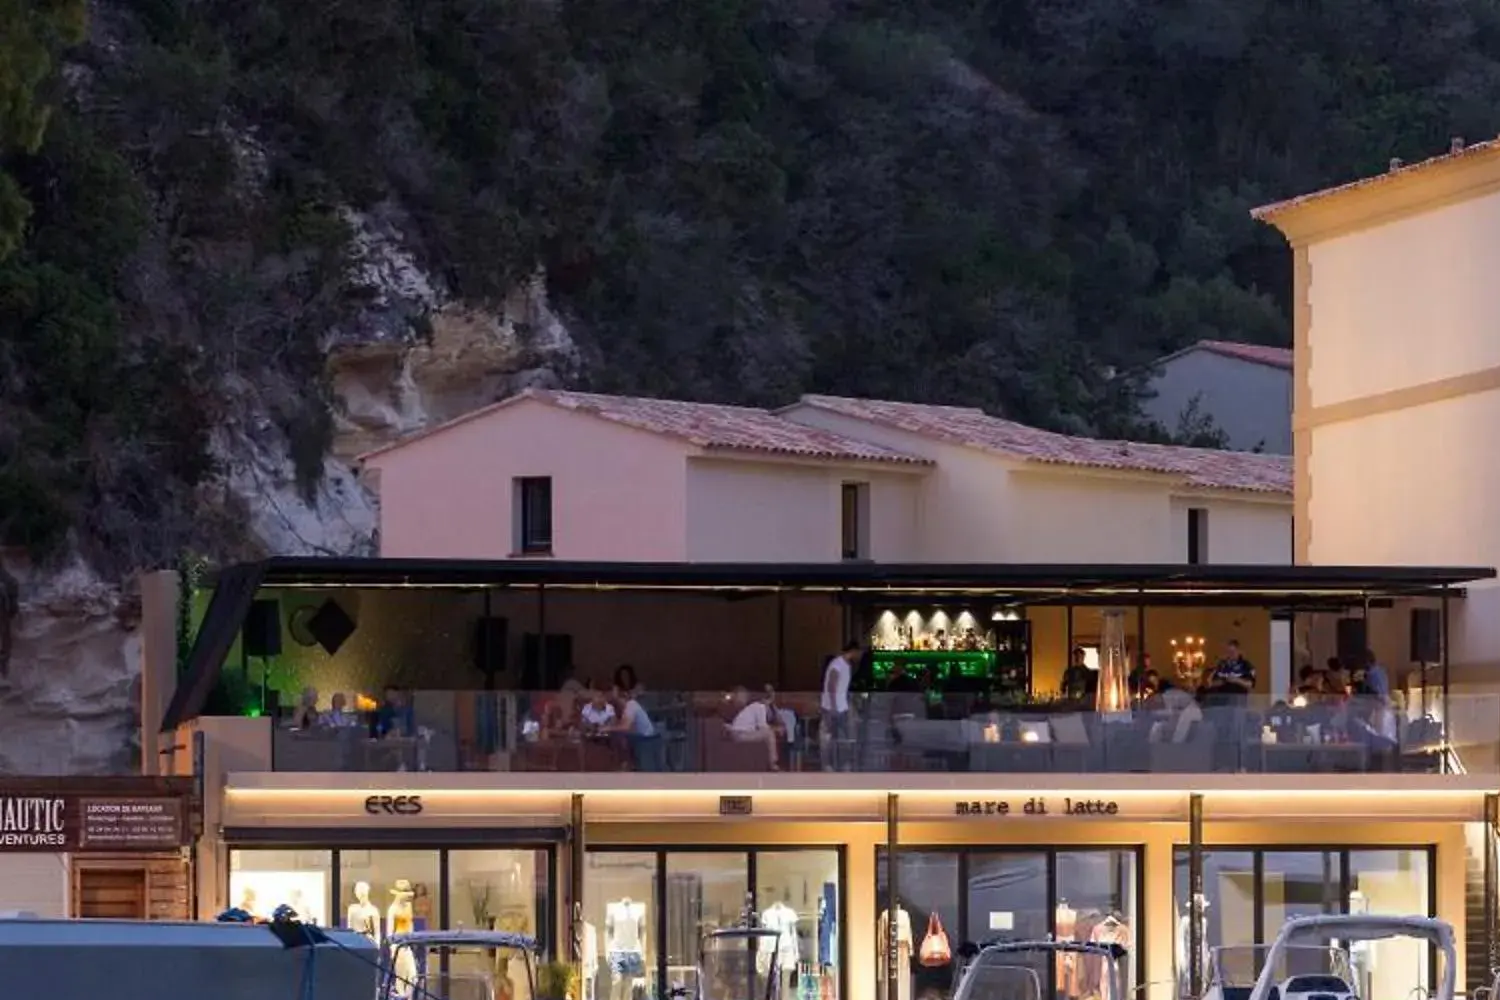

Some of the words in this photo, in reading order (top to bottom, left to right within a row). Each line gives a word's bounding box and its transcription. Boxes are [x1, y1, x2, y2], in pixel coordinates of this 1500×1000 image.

[365, 796, 423, 815] ERES
[955, 800, 1009, 815] mare
[1023, 796, 1048, 815] di
[1063, 797, 1119, 815] latte
